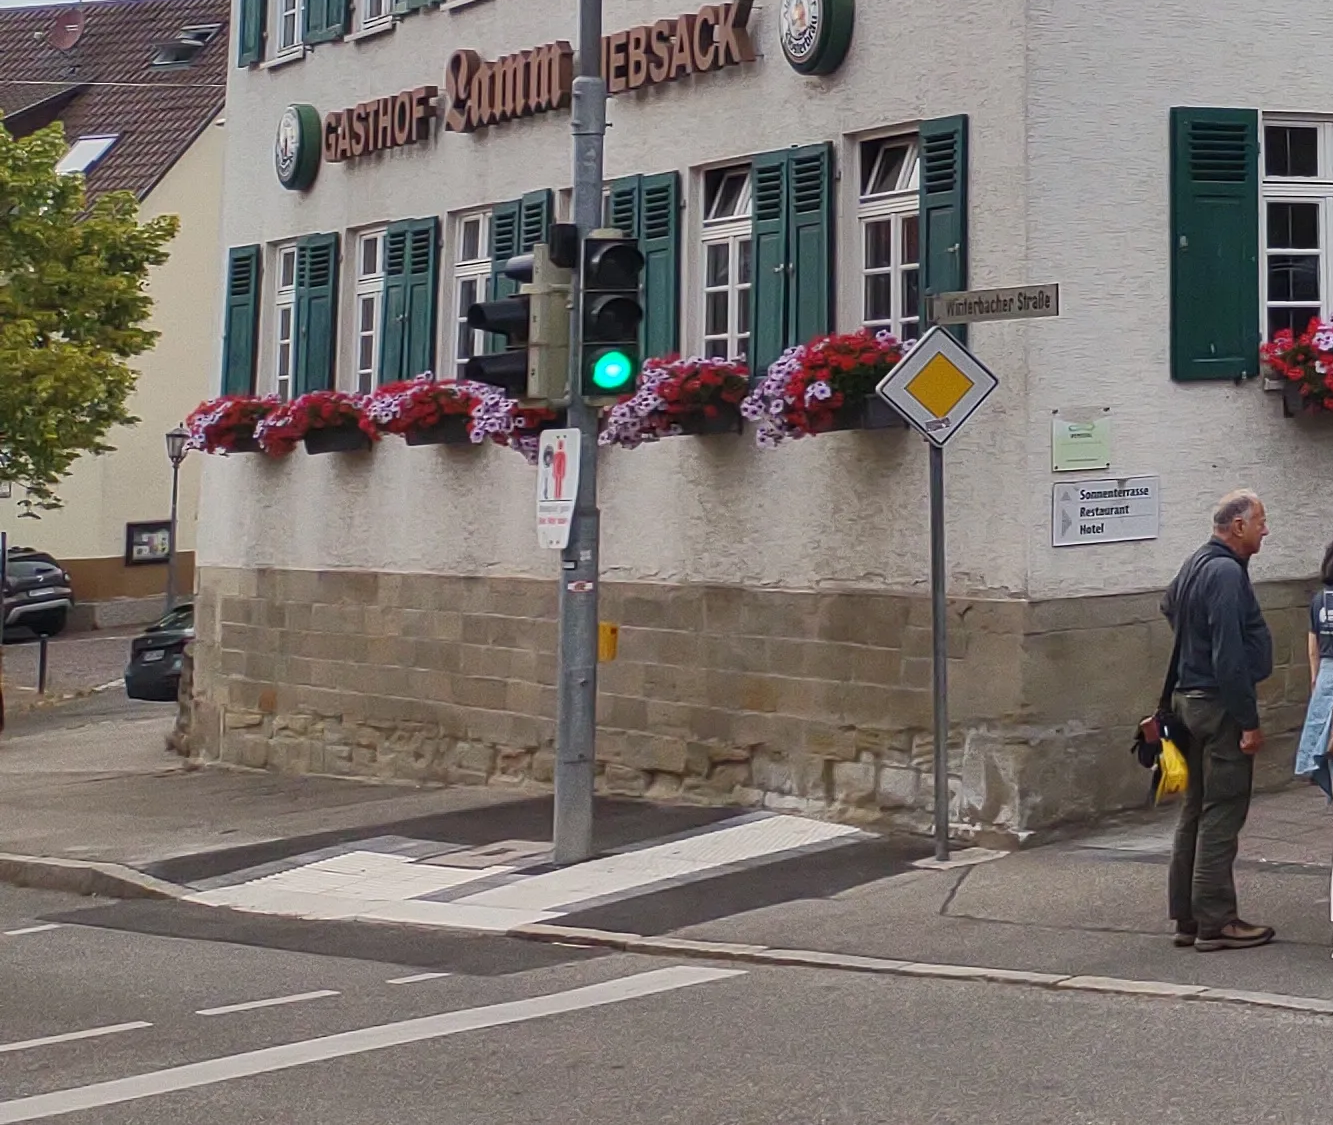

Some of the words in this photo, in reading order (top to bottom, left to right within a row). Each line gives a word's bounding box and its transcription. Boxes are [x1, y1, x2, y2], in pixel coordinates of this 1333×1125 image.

[445, 40, 574, 133] Lamm
[945, 296, 1015, 317] Winterbacher
[1017, 290, 1051, 311] Straße
[1079, 486, 1149, 501] Sonnenterrasse
[1079, 504, 1130, 518] Restaurant
[1079, 522, 1105, 536] Hotel
